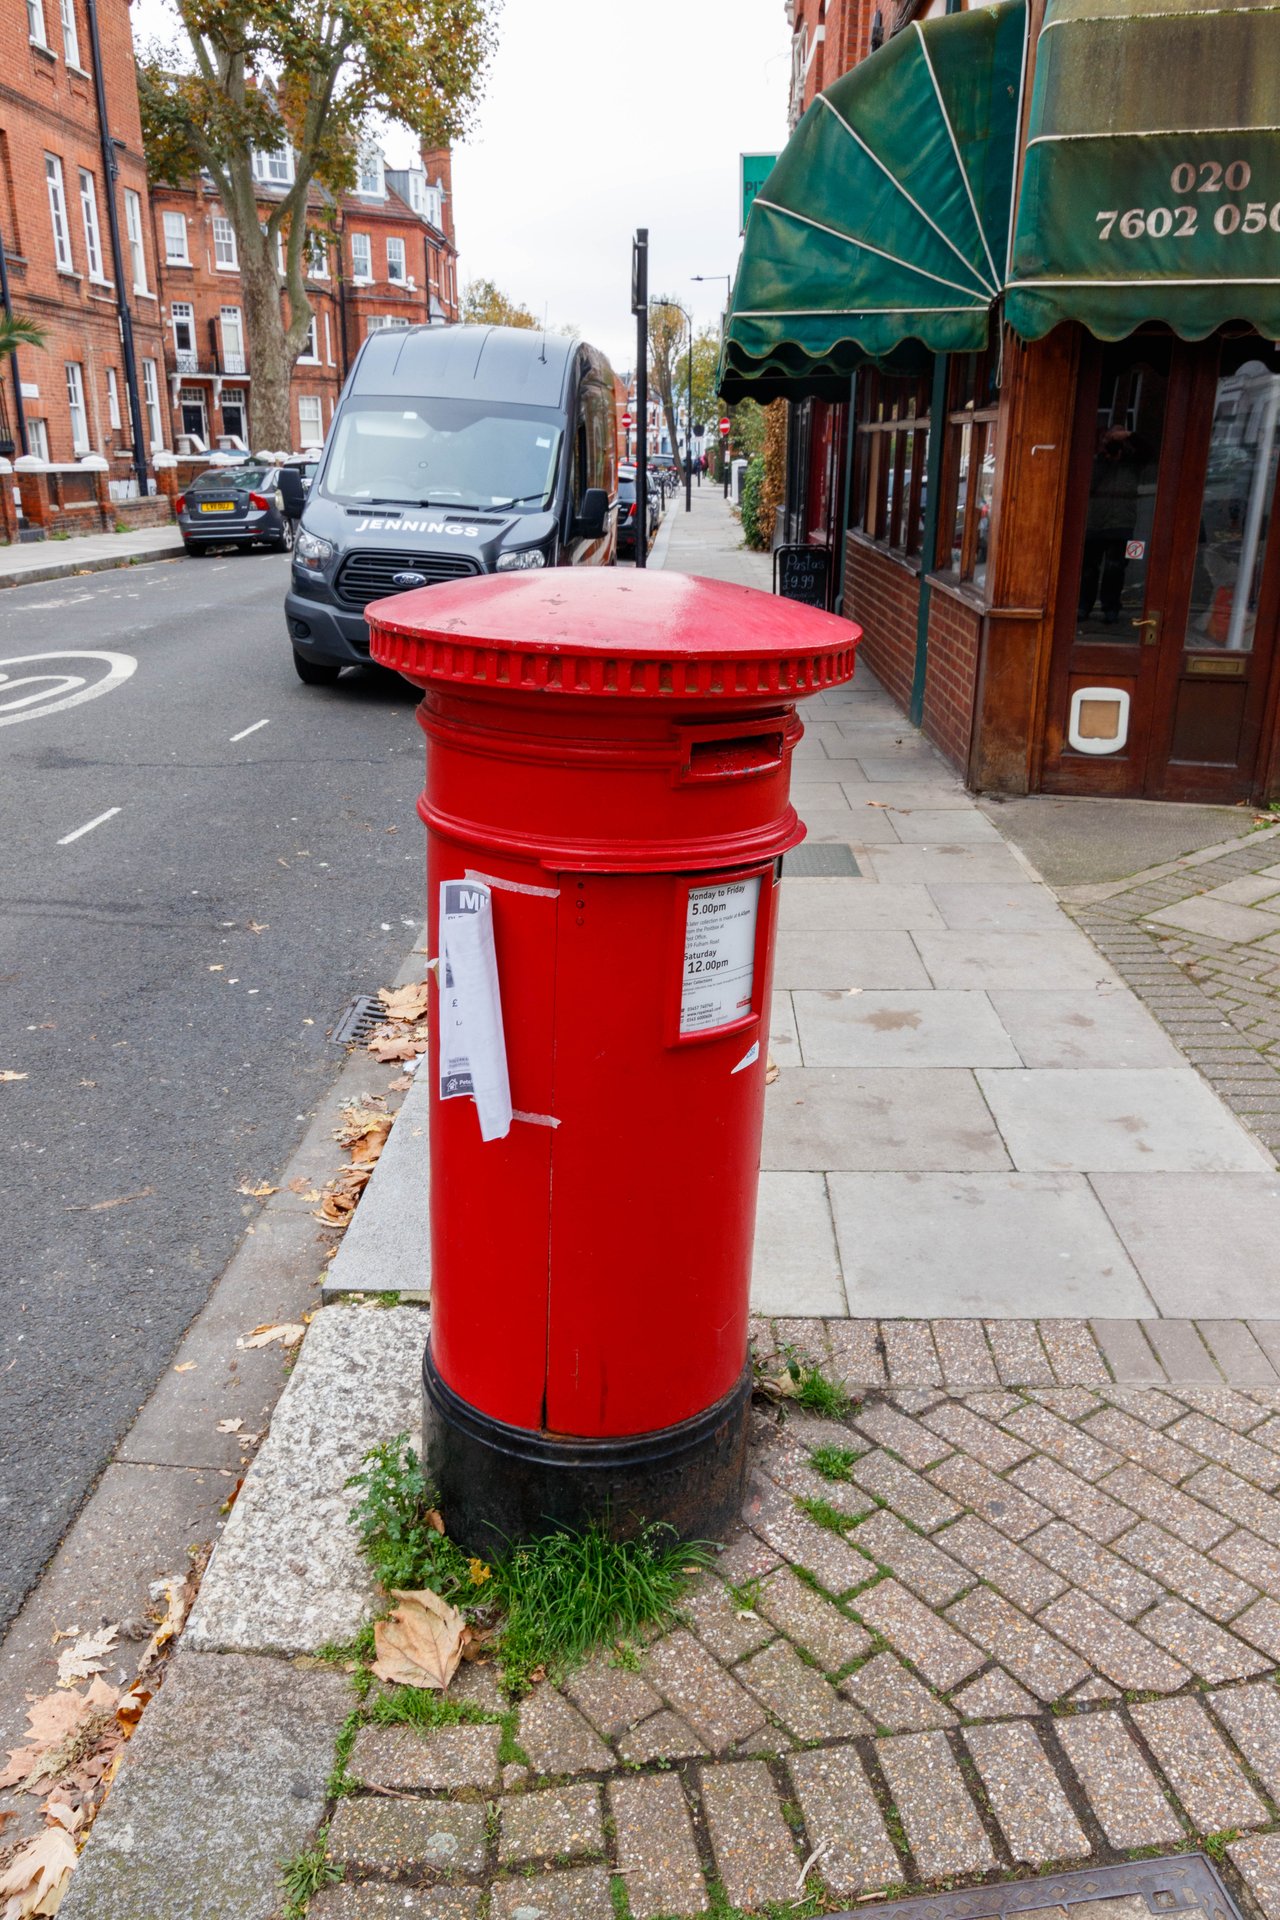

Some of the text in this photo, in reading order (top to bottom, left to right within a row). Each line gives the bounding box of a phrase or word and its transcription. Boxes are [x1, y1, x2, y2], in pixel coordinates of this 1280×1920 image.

[1170, 160, 1251, 193] 020
[1096, 206, 1198, 240] 7602
[355, 519, 479, 537] JENNINGS
[786, 552, 825, 570] Pastas
[400, 575, 420, 584] Ford
[783, 572, 814, 590] £9.99
[688, 891, 716, 901] Monday
[727, 885, 746, 895] Friday
[692, 903, 727, 915] 5.00pm
[684, 950, 717, 960] Saturday
[688, 959, 729, 974] 12.00pm
